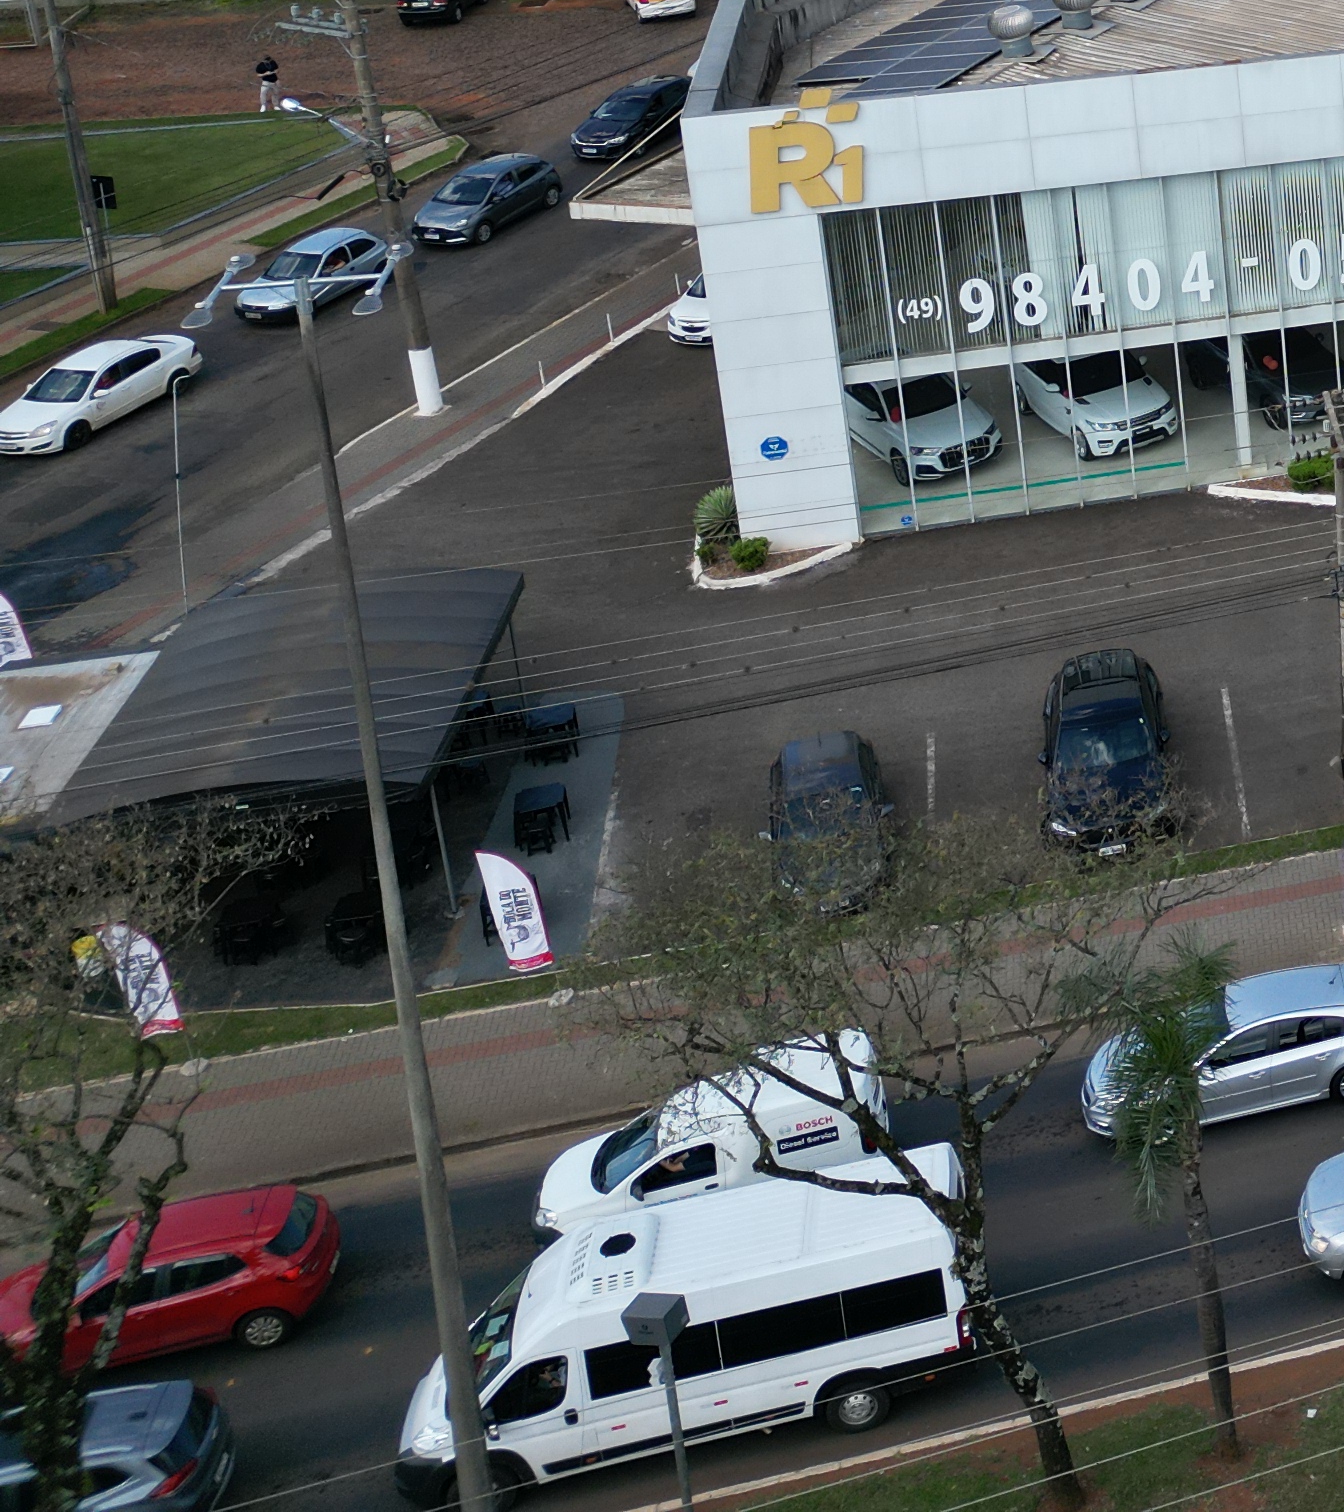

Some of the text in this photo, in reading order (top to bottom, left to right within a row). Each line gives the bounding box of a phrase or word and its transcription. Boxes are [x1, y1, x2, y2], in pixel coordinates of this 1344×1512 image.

[749, 120, 864, 214] R1
[897, 294, 944, 324] (49)
[795, 1115, 833, 1131] BOSCH
[781, 1131, 837, 1150] Diesel Service
